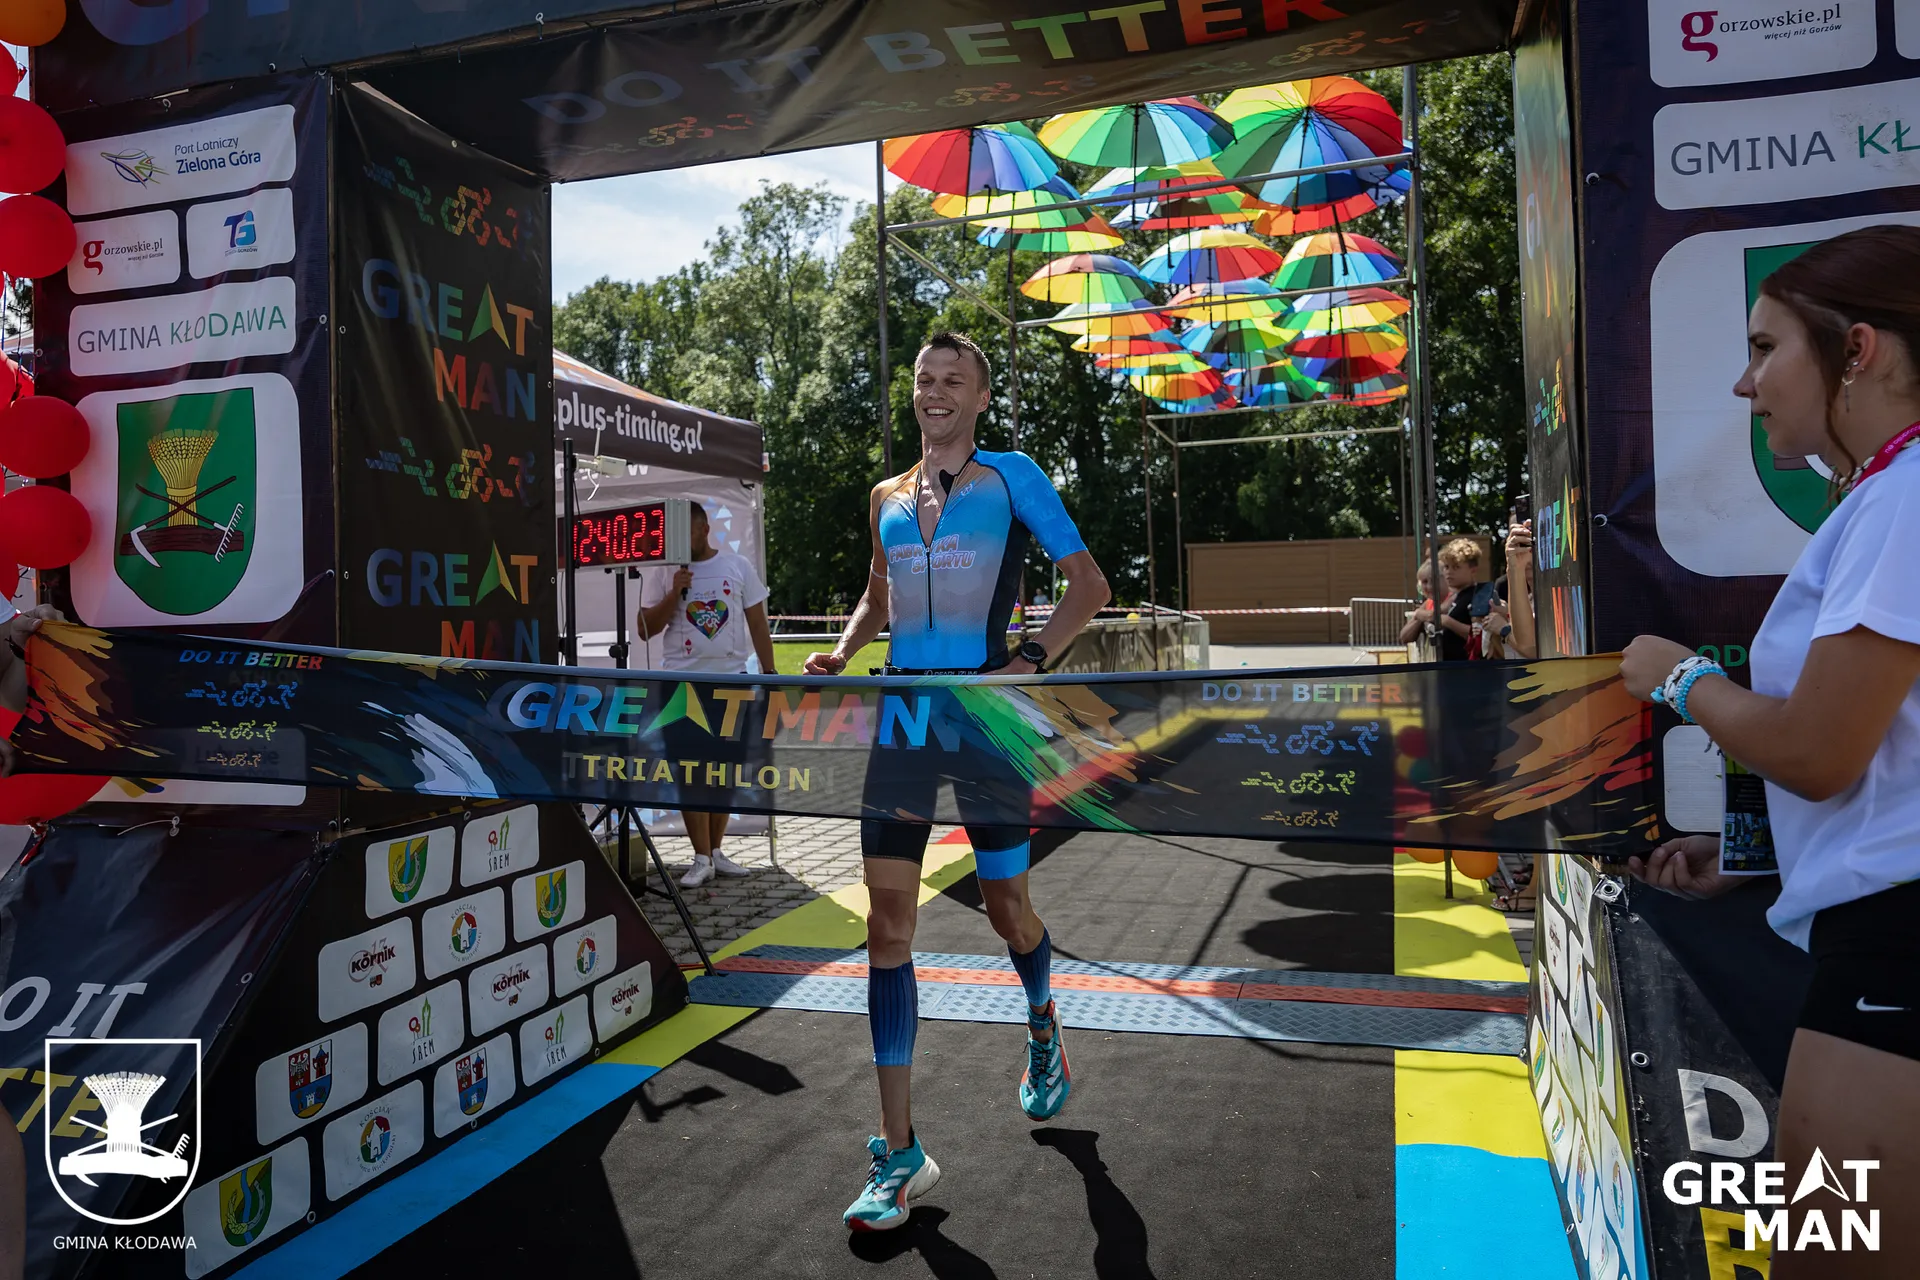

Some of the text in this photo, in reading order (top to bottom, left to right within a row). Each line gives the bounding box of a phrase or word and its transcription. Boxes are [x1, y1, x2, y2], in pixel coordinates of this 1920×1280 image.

[1764, 23, 1842, 40] więcej niż Gorzów
[174, 137, 239, 156] Port Lotniczy
[176, 149, 262, 175] Zielona Góra
[1670, 130, 1836, 176] GMINA
[77, 305, 287, 354] GMINA KŁODAWA
[362, 257, 535, 357] GREAT
[433, 346, 536, 422] MAN
[366, 539, 538, 607] GREAT
[179, 649, 324, 670] DO IT BETTER
[440, 618, 541, 664] MAN
[1202, 682, 1403, 703] DO IT BETTER
[583, 754, 811, 792] TRIATHLON
[46, 981, 148, 1039] IT
